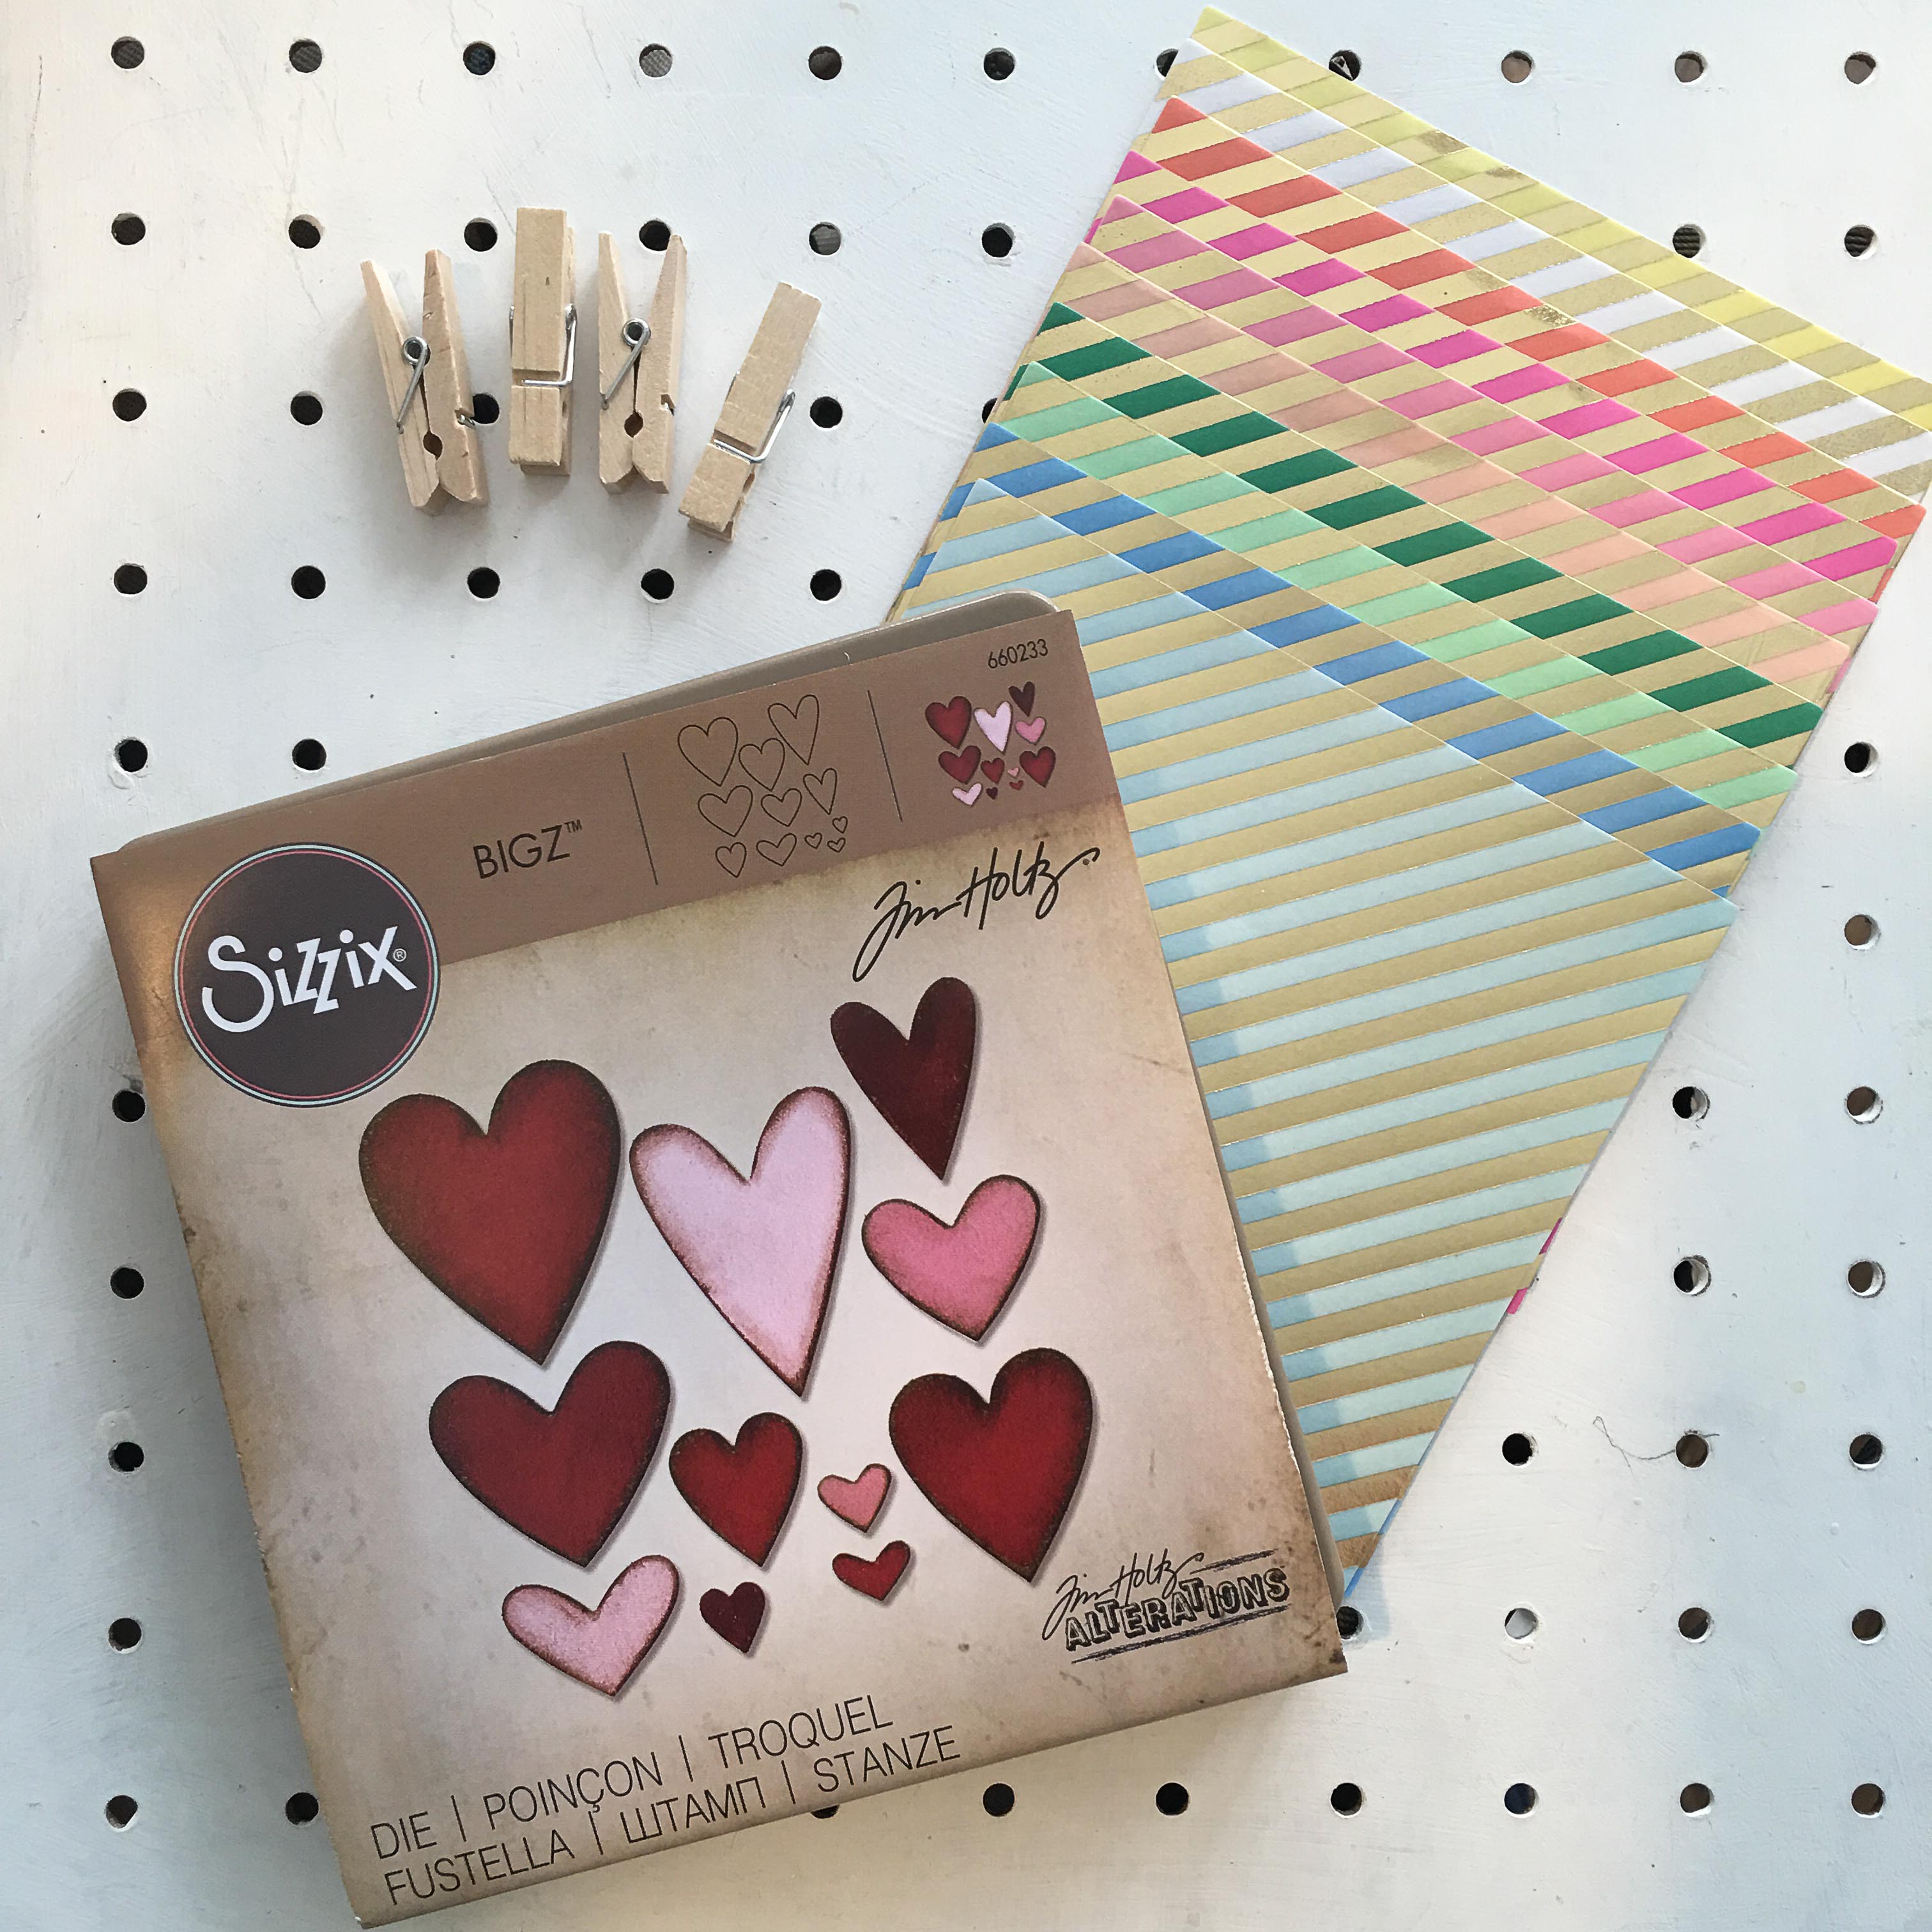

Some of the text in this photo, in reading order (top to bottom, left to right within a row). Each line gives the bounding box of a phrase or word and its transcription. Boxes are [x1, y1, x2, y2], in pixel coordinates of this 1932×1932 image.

[988, 639, 1048, 669] 660233
[956, 841, 1100, 930] Holtz
[1064, 1567, 1291, 1652] ALTERATIONS
[1110, 1548, 1204, 1606] Holtz
[371, 1695, 893, 1860] DIE POINÇON TROQUEL
[385, 1725, 962, 1905] FUSTELLA ШТАМП STANZE
